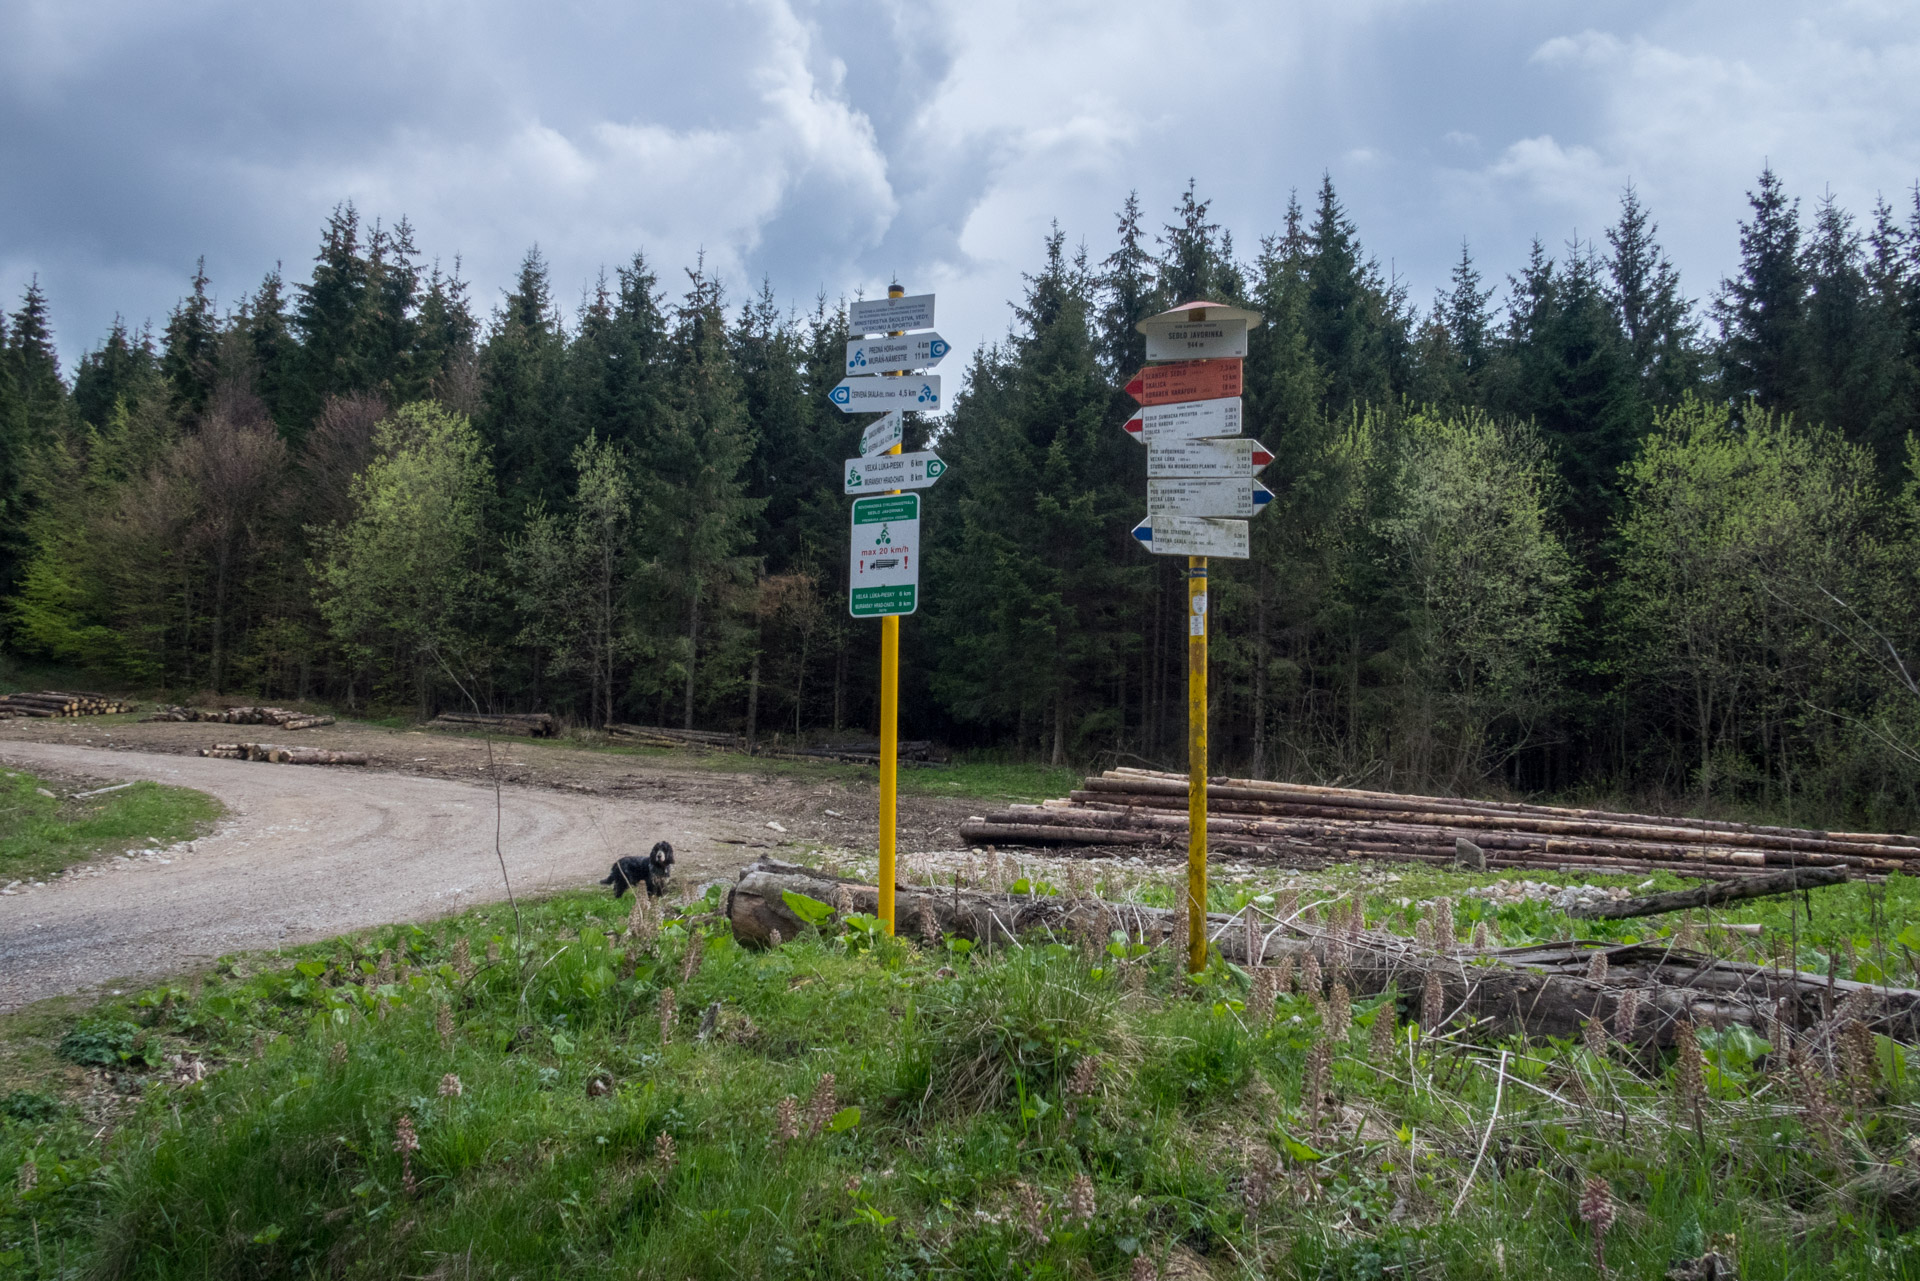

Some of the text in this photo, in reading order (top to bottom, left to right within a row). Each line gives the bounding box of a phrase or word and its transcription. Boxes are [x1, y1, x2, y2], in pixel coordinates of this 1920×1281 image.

[1168, 330, 1223, 340] SEDLO JAVORINKA
[922, 352, 929, 360] km
[899, 389, 907, 397] 4,5
[879, 547, 888, 555] 20
[891, 545, 909, 554] km/h
